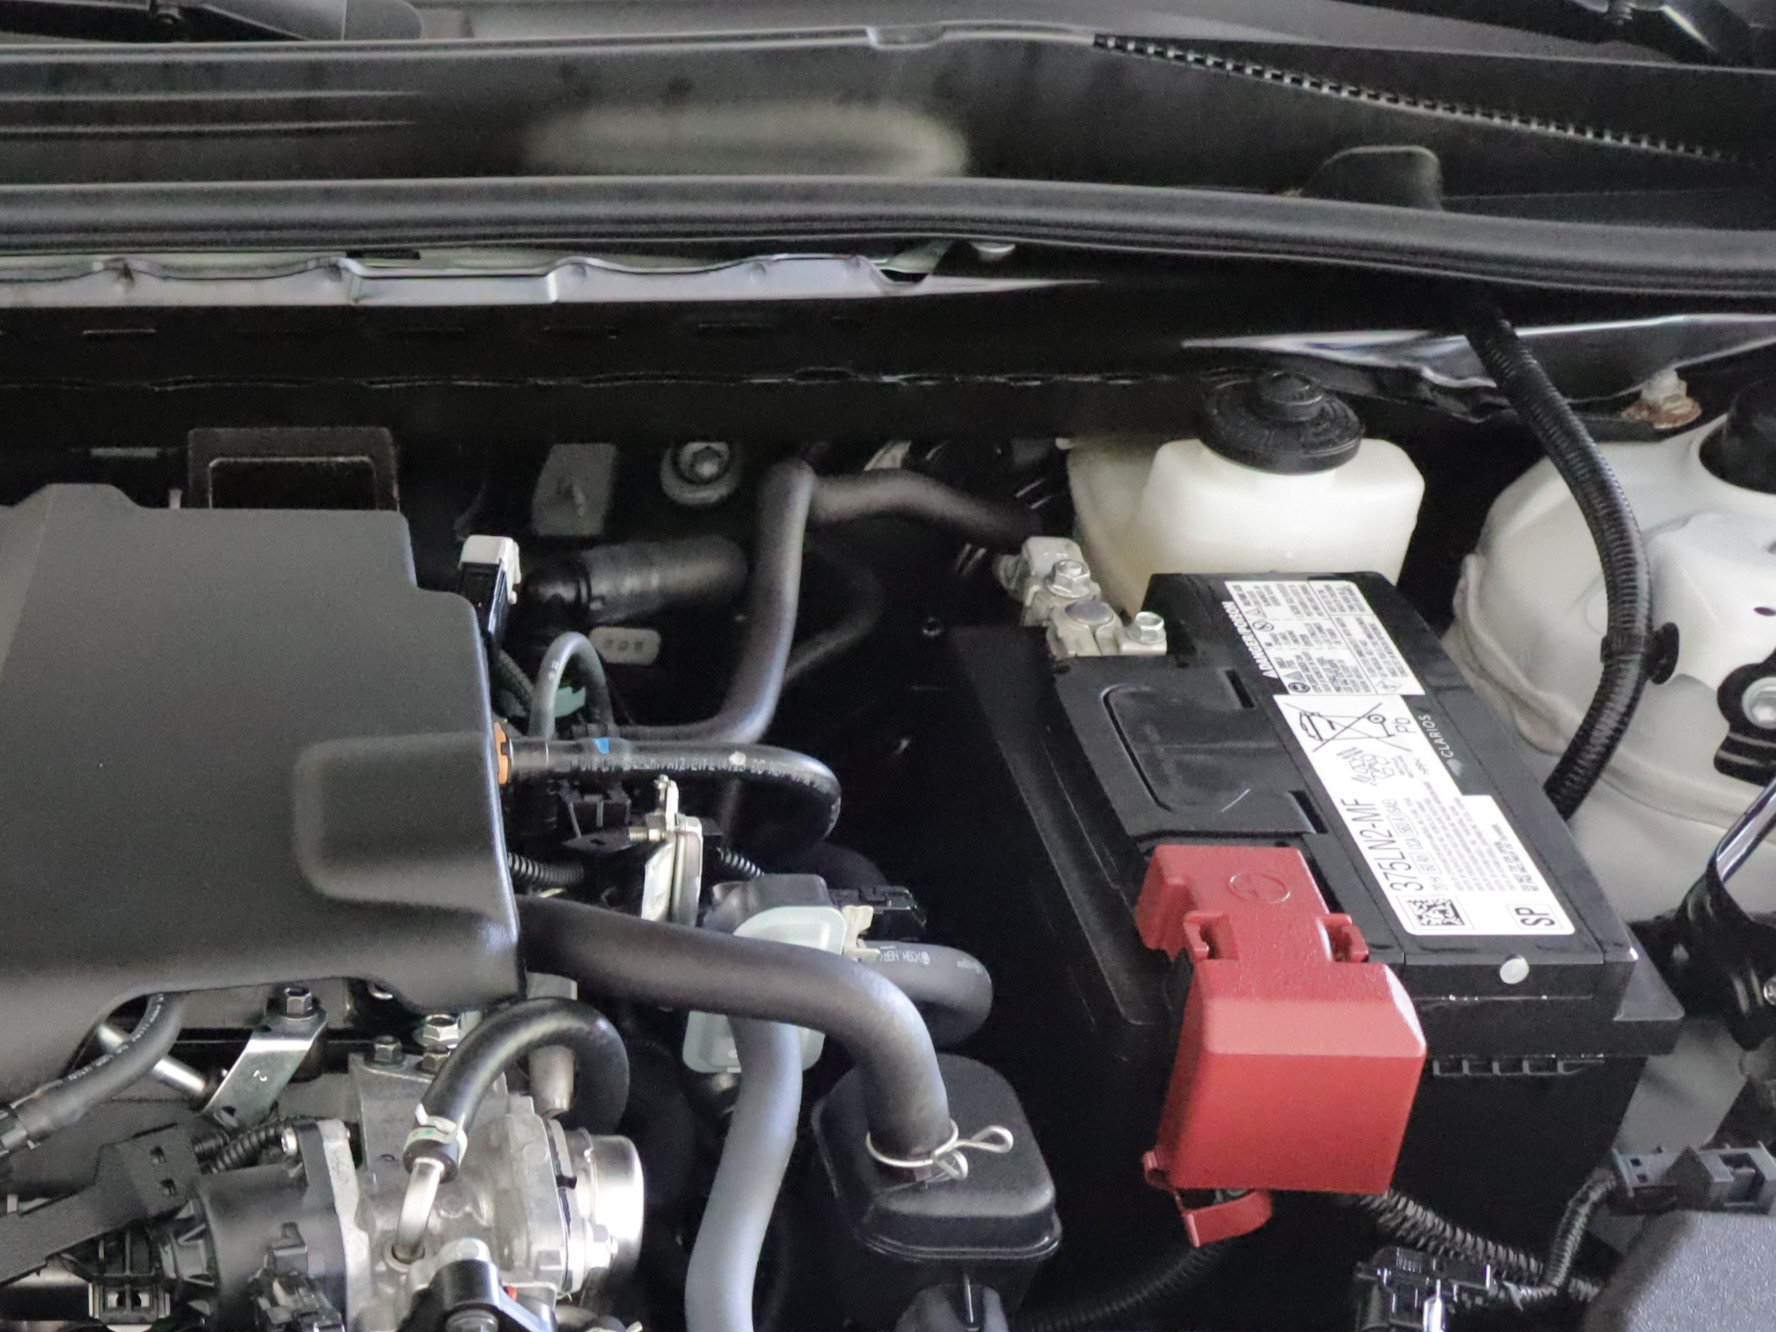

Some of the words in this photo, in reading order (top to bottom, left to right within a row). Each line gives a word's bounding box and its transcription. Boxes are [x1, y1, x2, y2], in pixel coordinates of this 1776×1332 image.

[1392, 717, 1417, 733] Pb
[1418, 715, 1453, 757] CLARIOS
[1341, 799, 1424, 891] 375LN2-MF
[1514, 907, 1555, 926] SP
